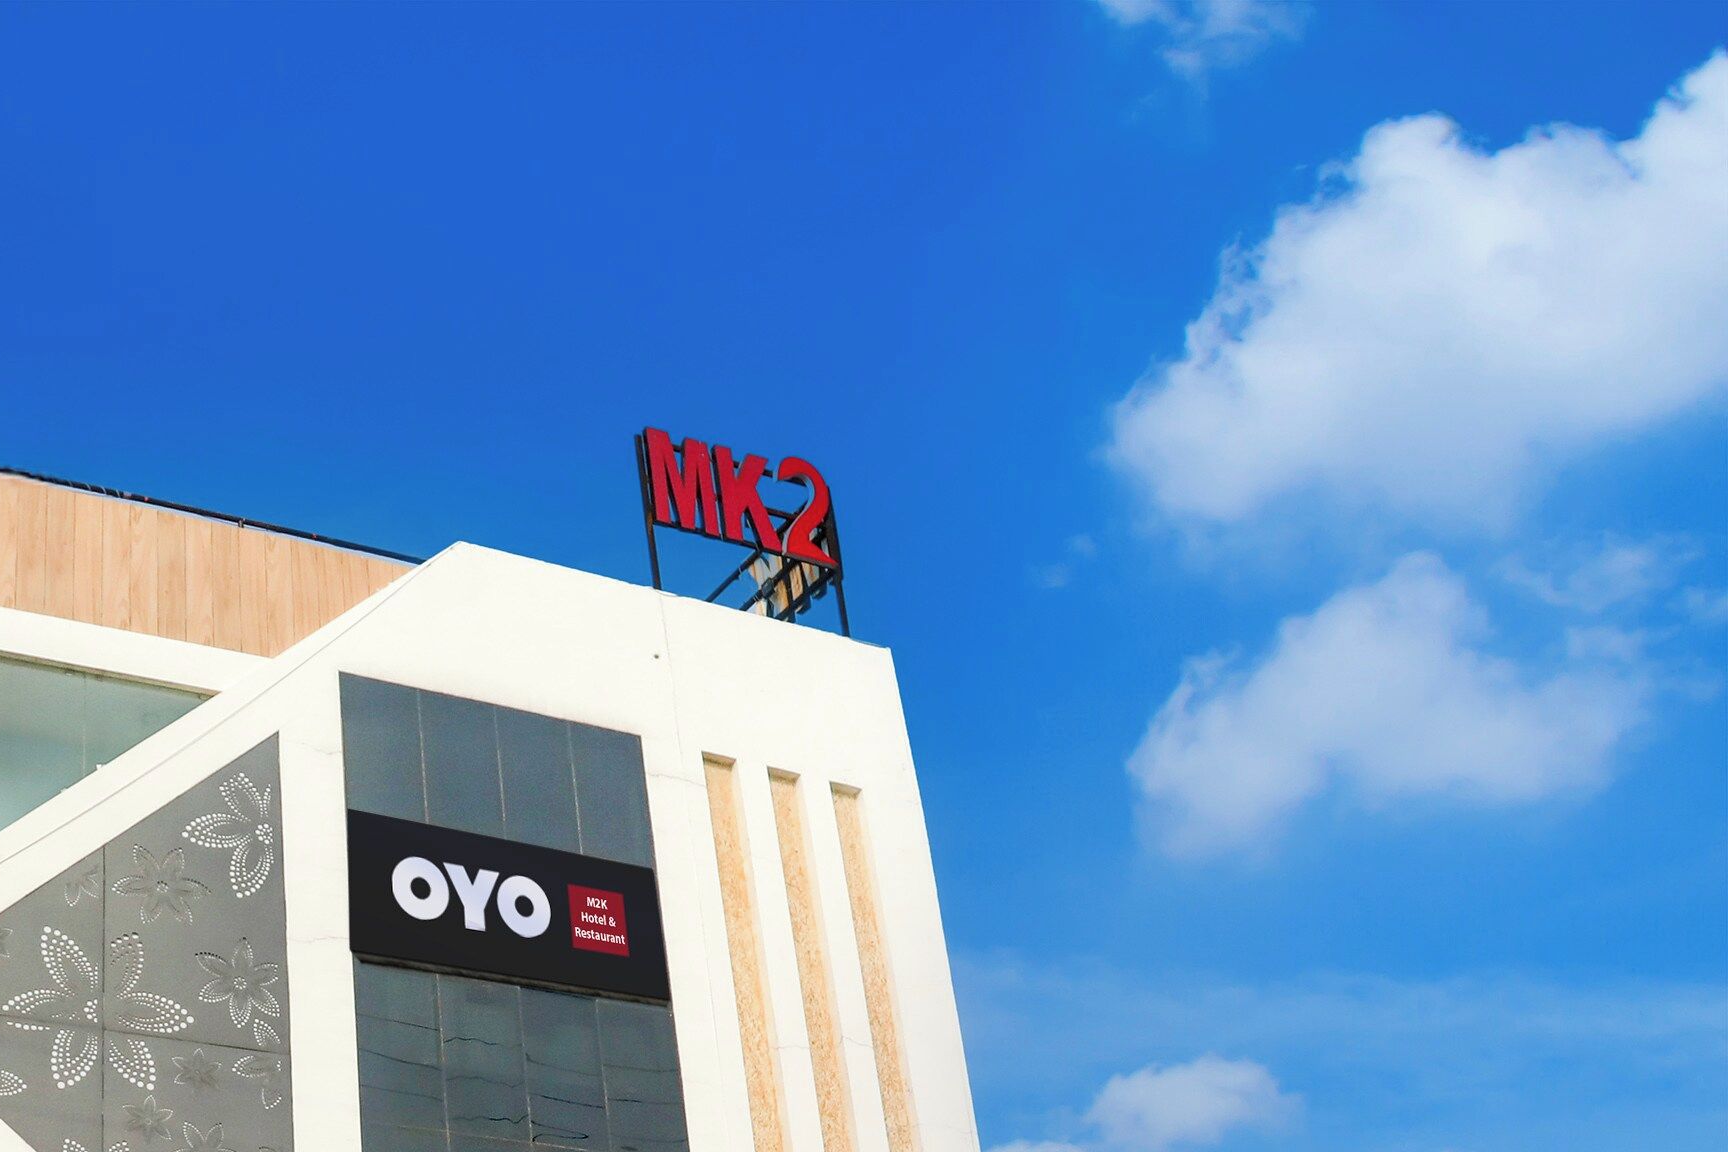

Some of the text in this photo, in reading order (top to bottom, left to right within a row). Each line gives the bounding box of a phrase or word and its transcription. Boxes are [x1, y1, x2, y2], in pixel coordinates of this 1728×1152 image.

[642, 426, 839, 568] MK2
[391, 856, 552, 938] OYO
[586, 896, 608, 910] M2K
[581, 911, 616, 928] Hotel &
[574, 926, 626, 945] Restaurant
